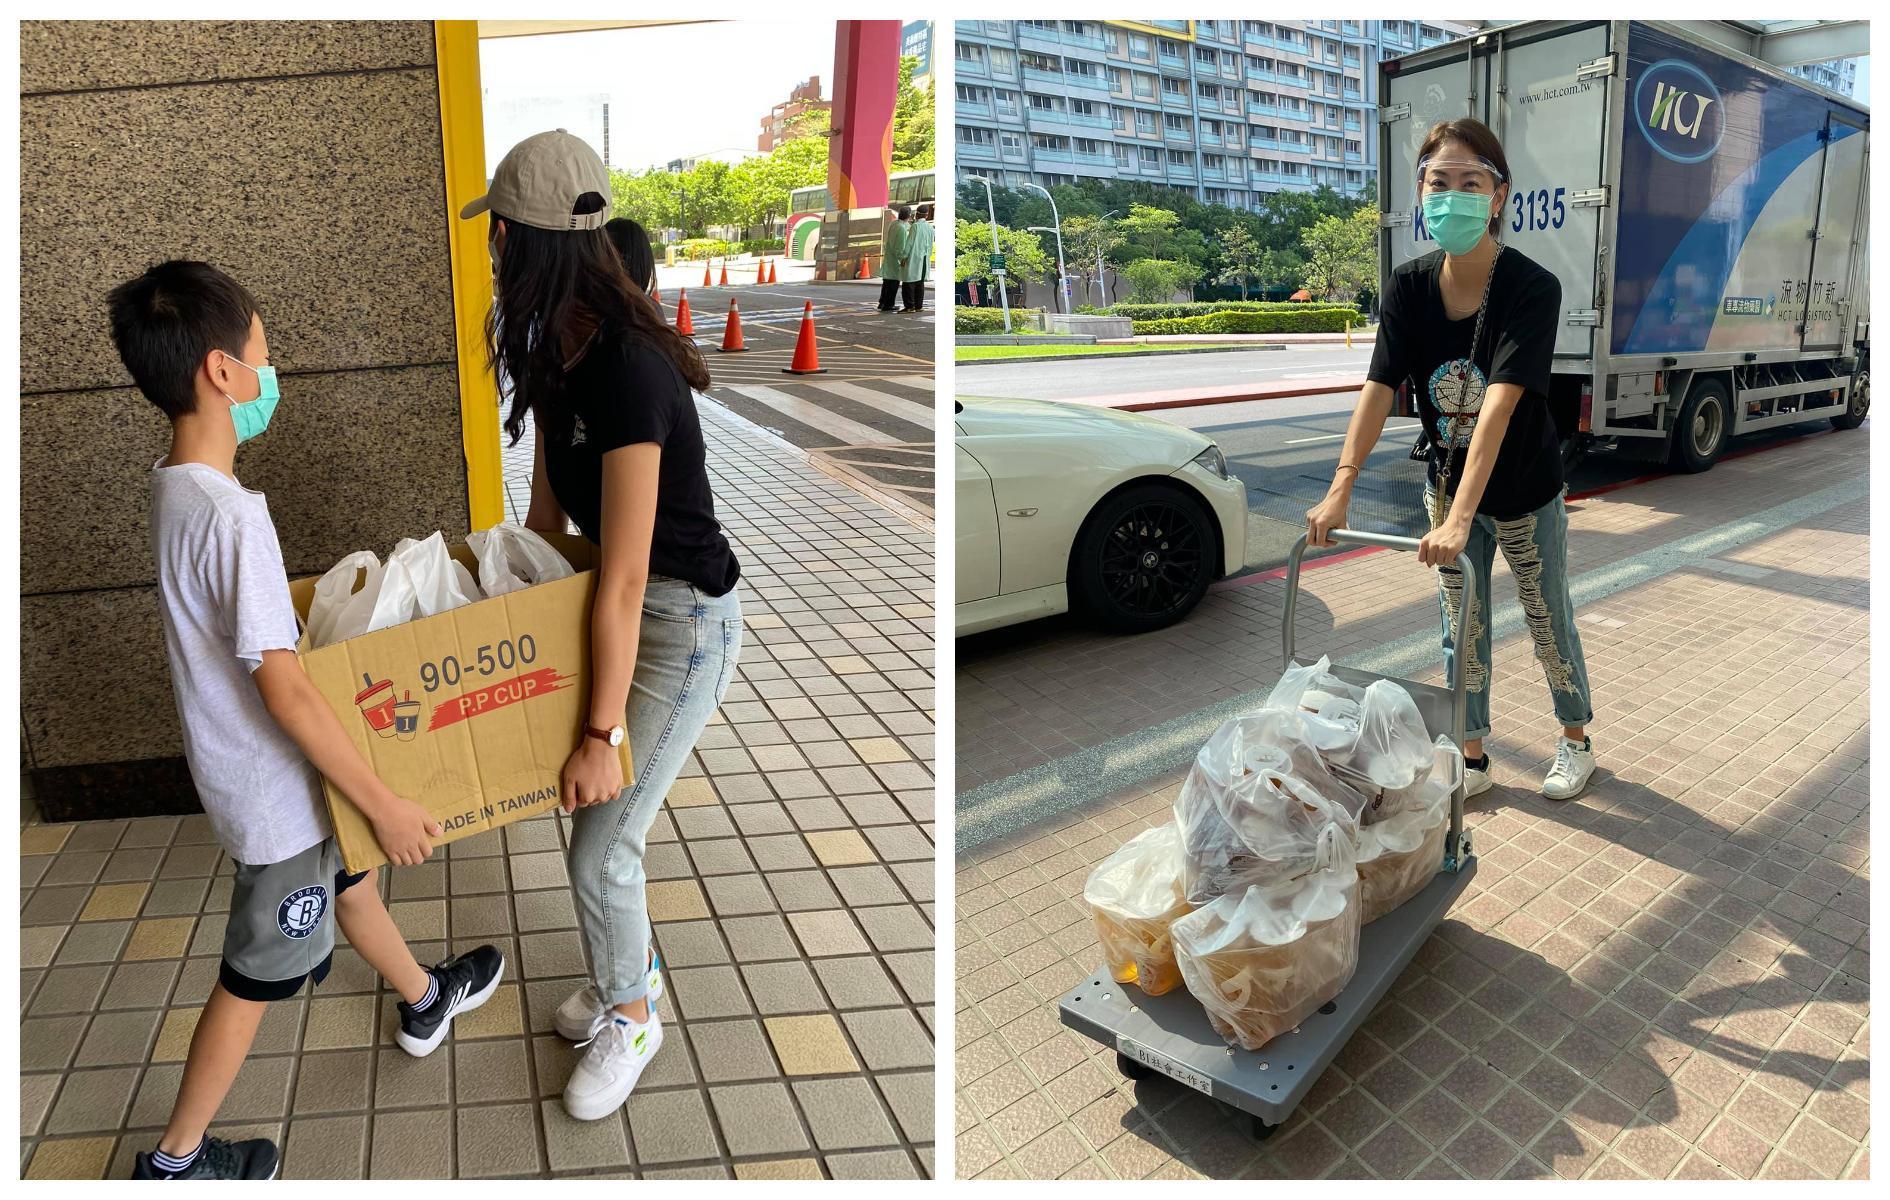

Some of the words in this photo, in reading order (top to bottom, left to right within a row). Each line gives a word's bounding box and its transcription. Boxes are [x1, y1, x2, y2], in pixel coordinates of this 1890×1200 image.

[1519, 81, 1593, 106] www.hct.com.tw
[1649, 81, 1715, 140] HCT
[1511, 187, 1566, 233] 3135
[420, 634, 537, 693] 90-500
[494, 678, 537, 704] CUP
[438, 811, 477, 833] ADE
[479, 804, 495, 821] IN
[497, 785, 558, 814] TAIWAN
[281, 923, 298, 937] NEW
